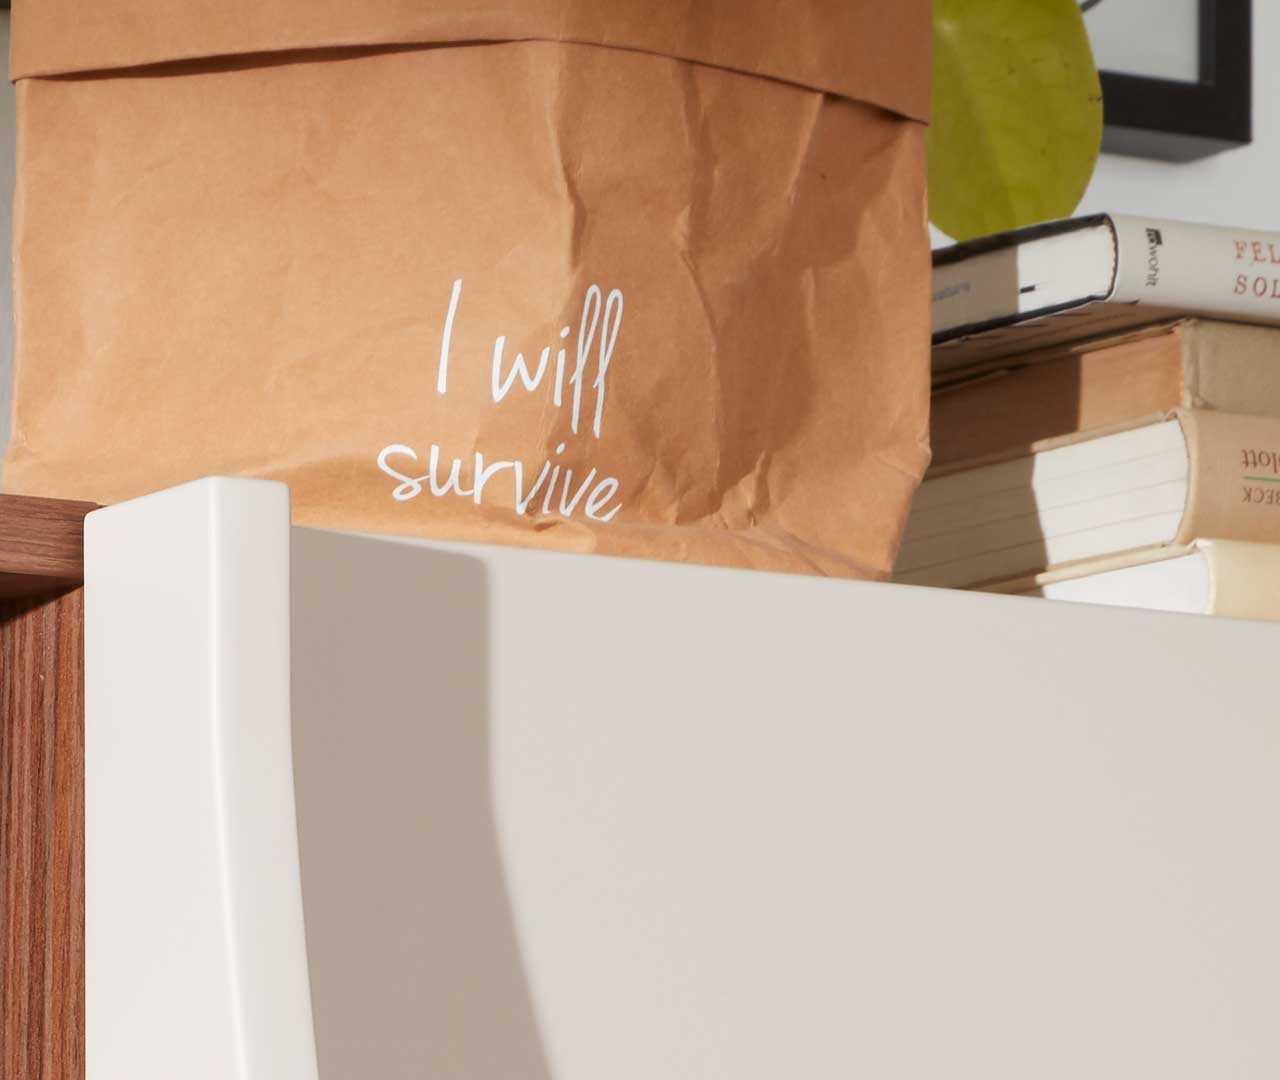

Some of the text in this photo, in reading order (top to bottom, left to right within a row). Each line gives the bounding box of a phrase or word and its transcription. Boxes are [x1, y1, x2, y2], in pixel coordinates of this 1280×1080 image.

[437, 278, 624, 439] I will
[376, 442, 623, 522] survive
